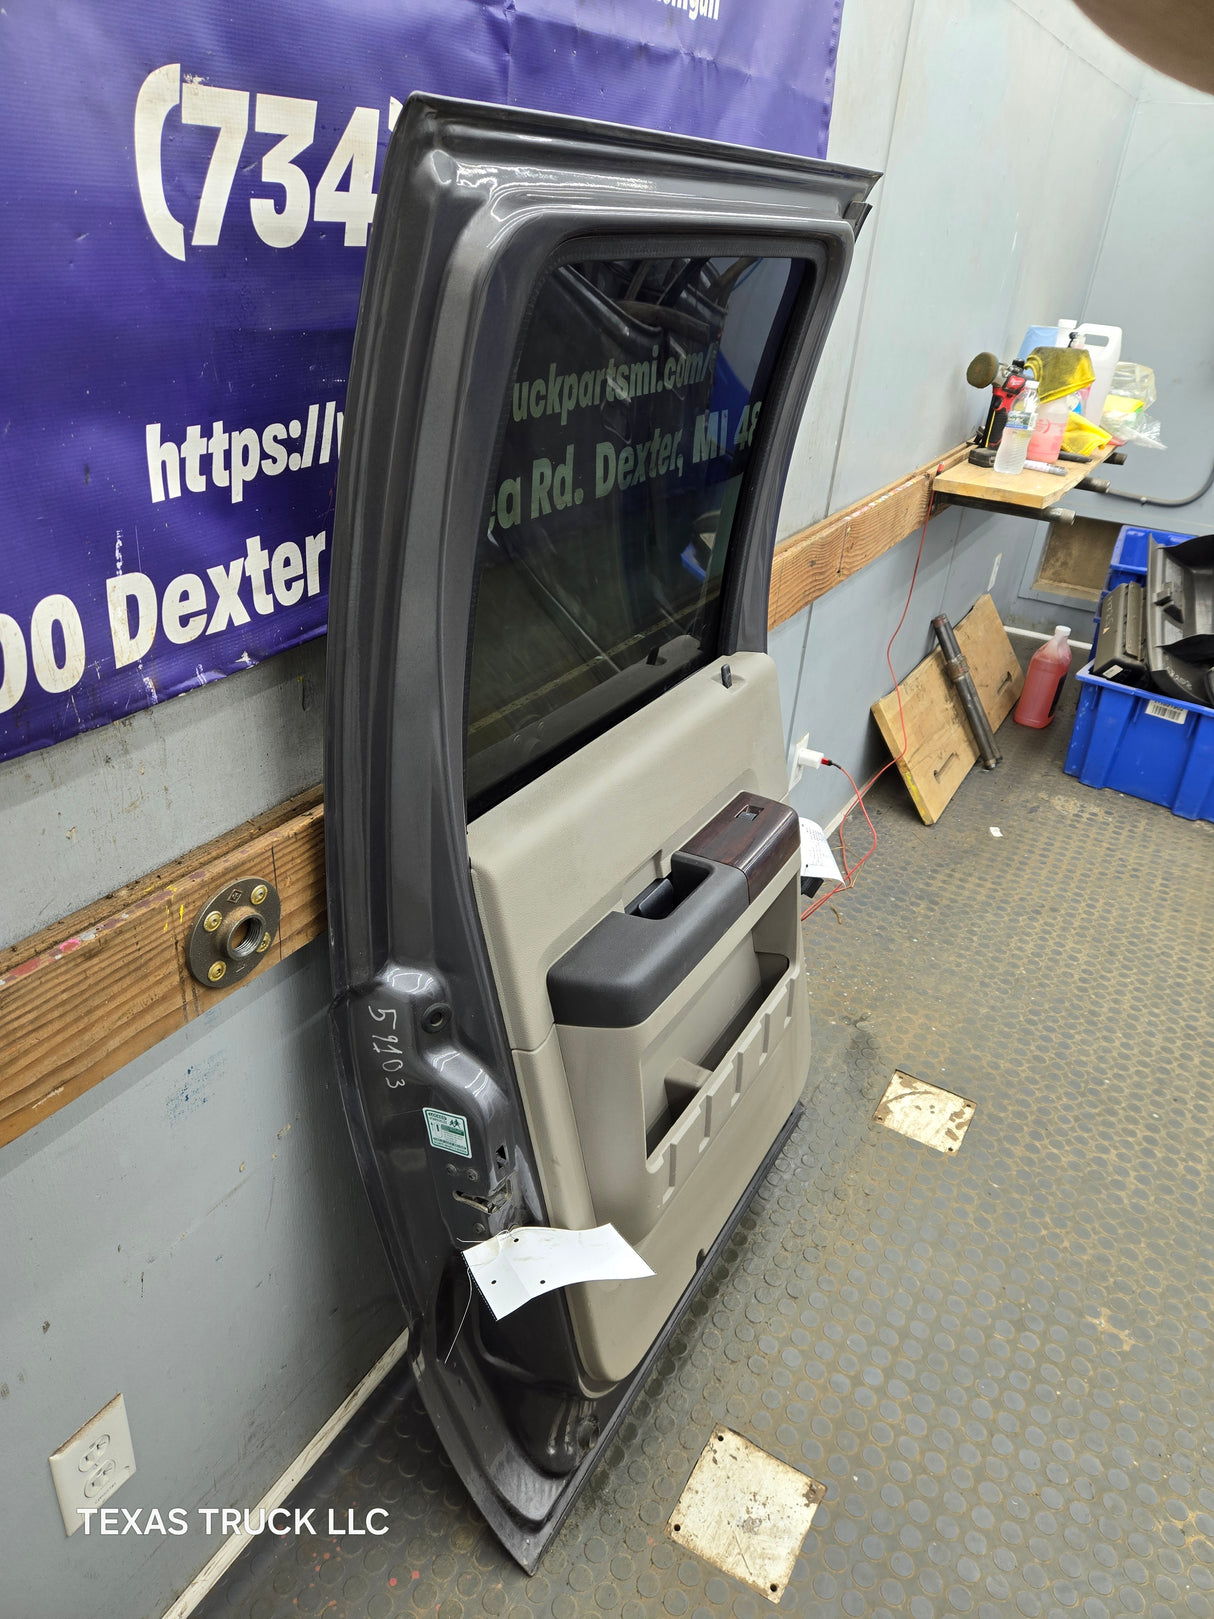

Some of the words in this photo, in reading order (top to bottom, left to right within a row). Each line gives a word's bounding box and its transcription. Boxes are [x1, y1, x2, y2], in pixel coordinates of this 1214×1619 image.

[134, 63, 402, 261] (734
[106, 531, 326, 669] Dexter
[531, 443, 584, 519] Rd.
[595, 428, 683, 499] Dexter,
[693, 409, 729, 464] MI
[146, 401, 345, 503] https://
